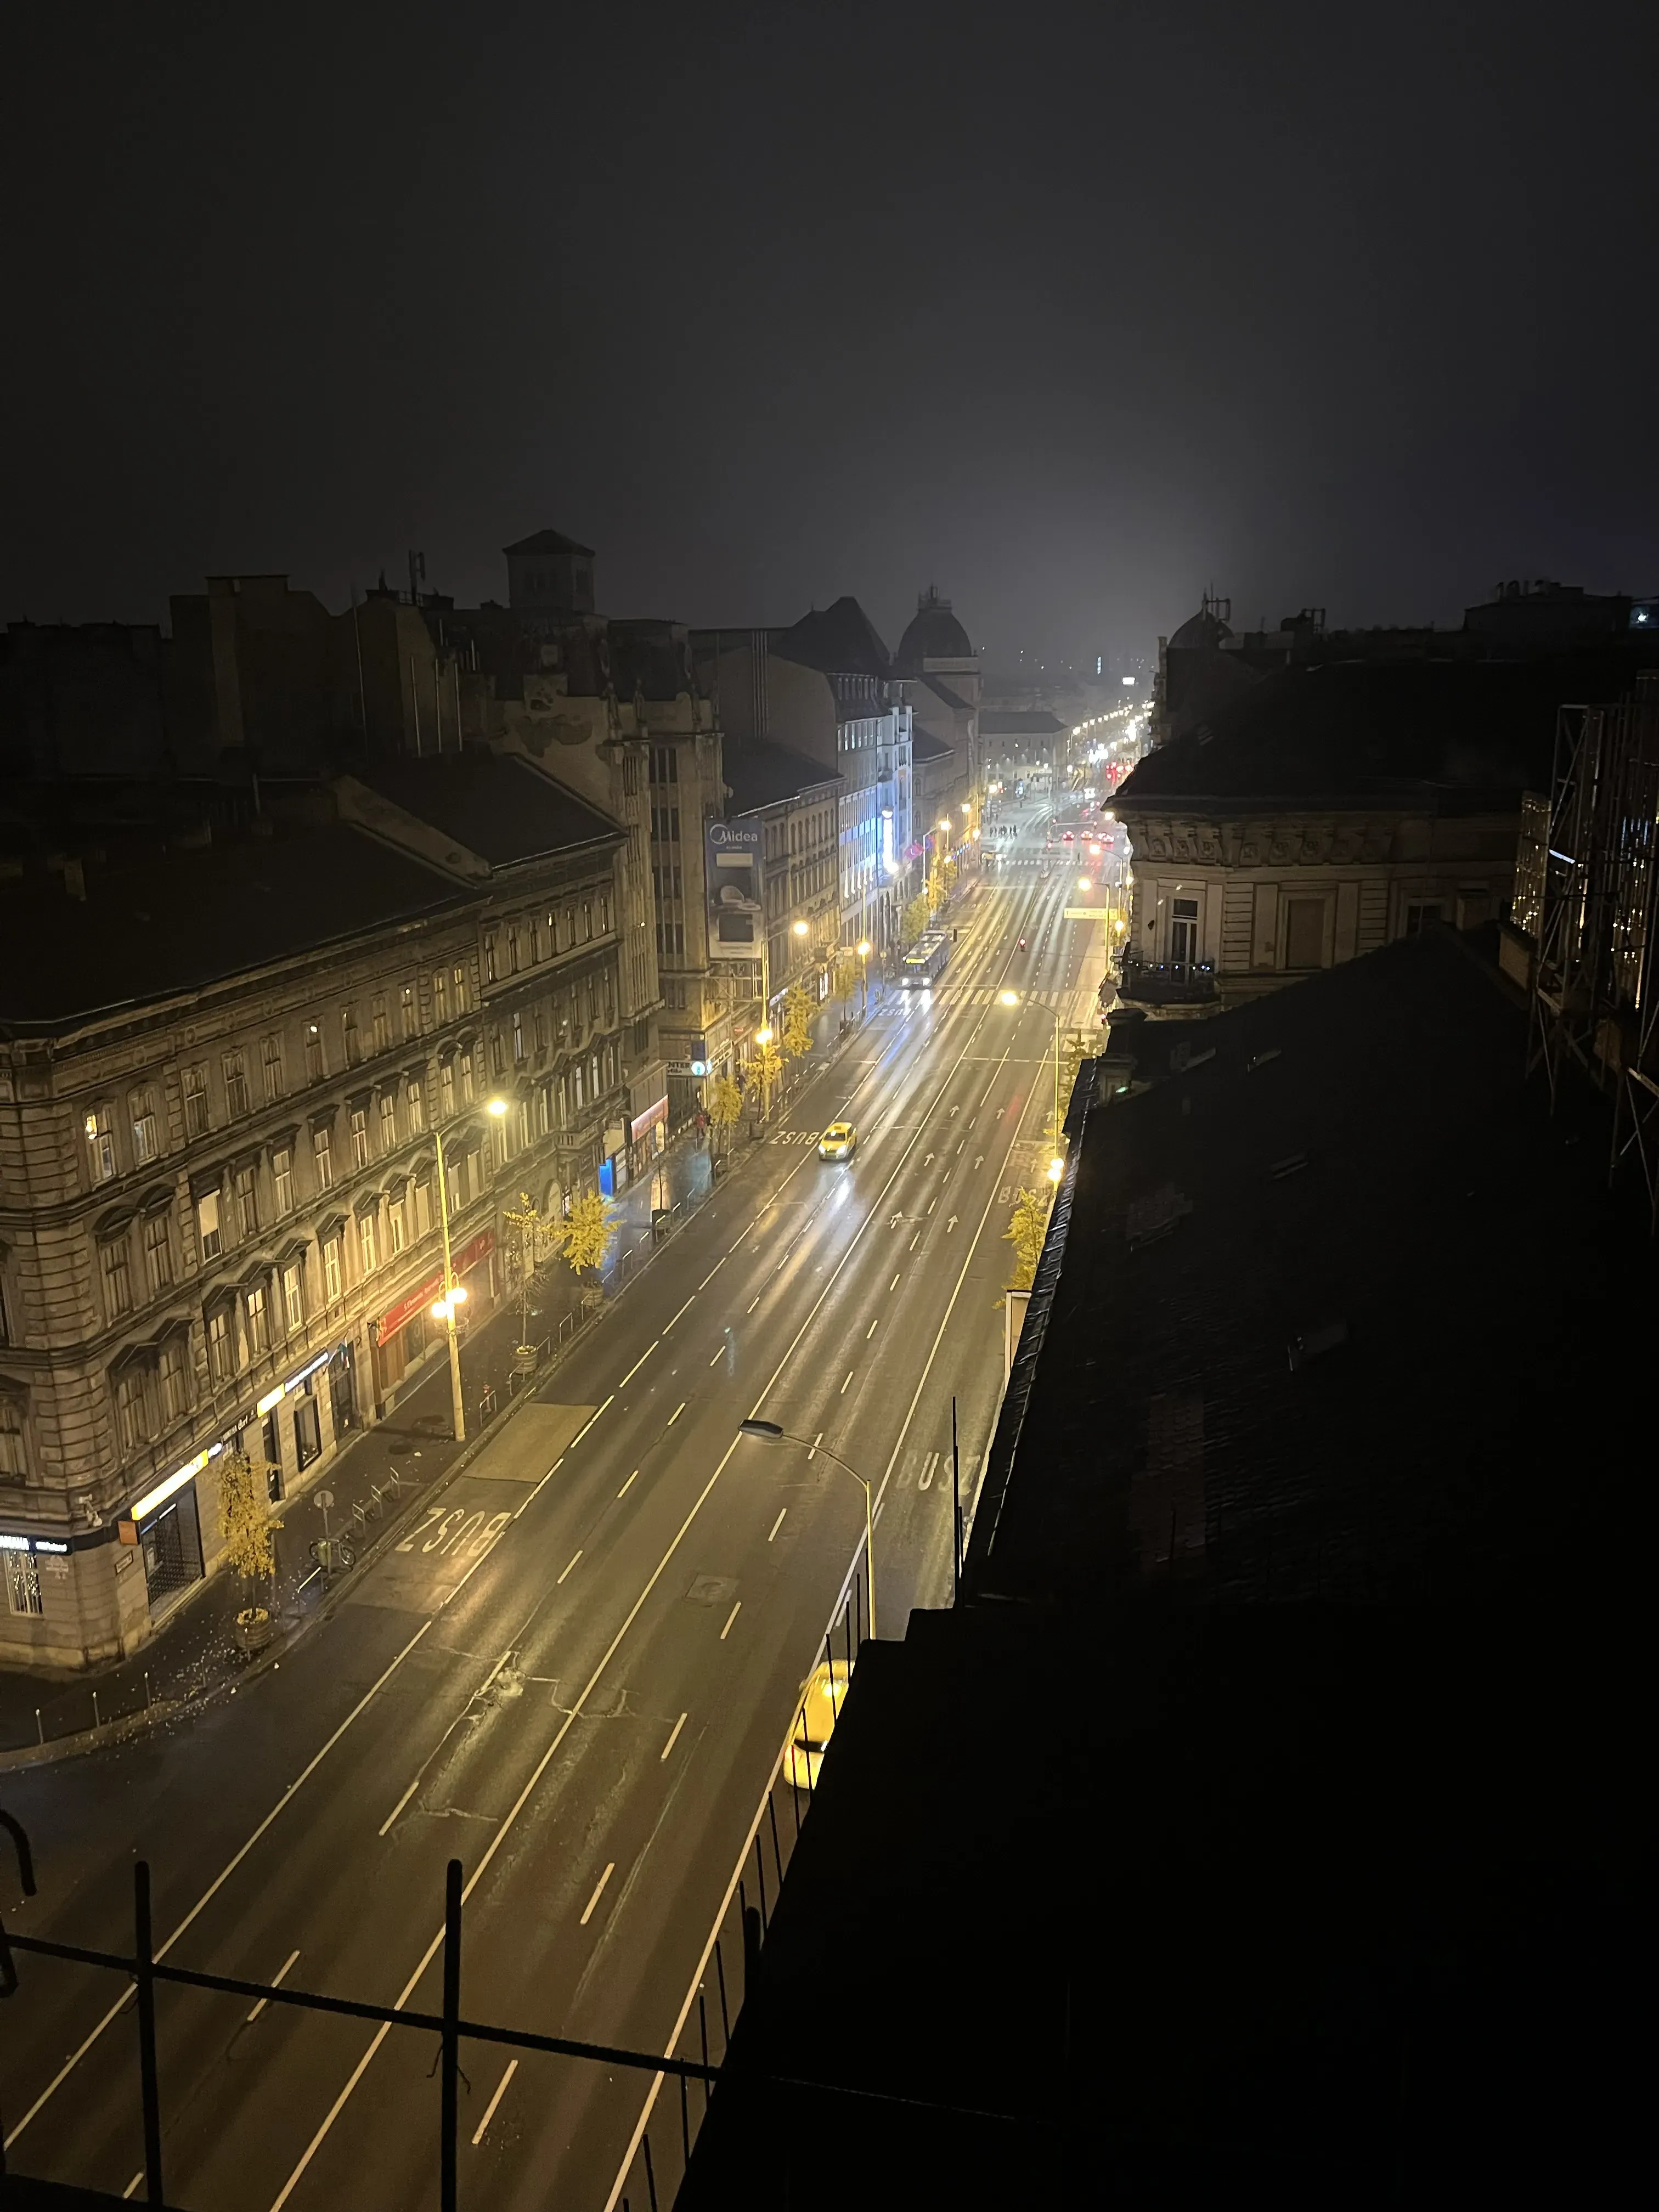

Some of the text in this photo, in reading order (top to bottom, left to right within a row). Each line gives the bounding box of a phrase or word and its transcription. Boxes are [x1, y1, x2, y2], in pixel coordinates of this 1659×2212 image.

[719, 830, 758, 842] Midea
[769, 1131, 820, 1145] BUSZ
[394, 1507, 512, 1557] BUSZ
